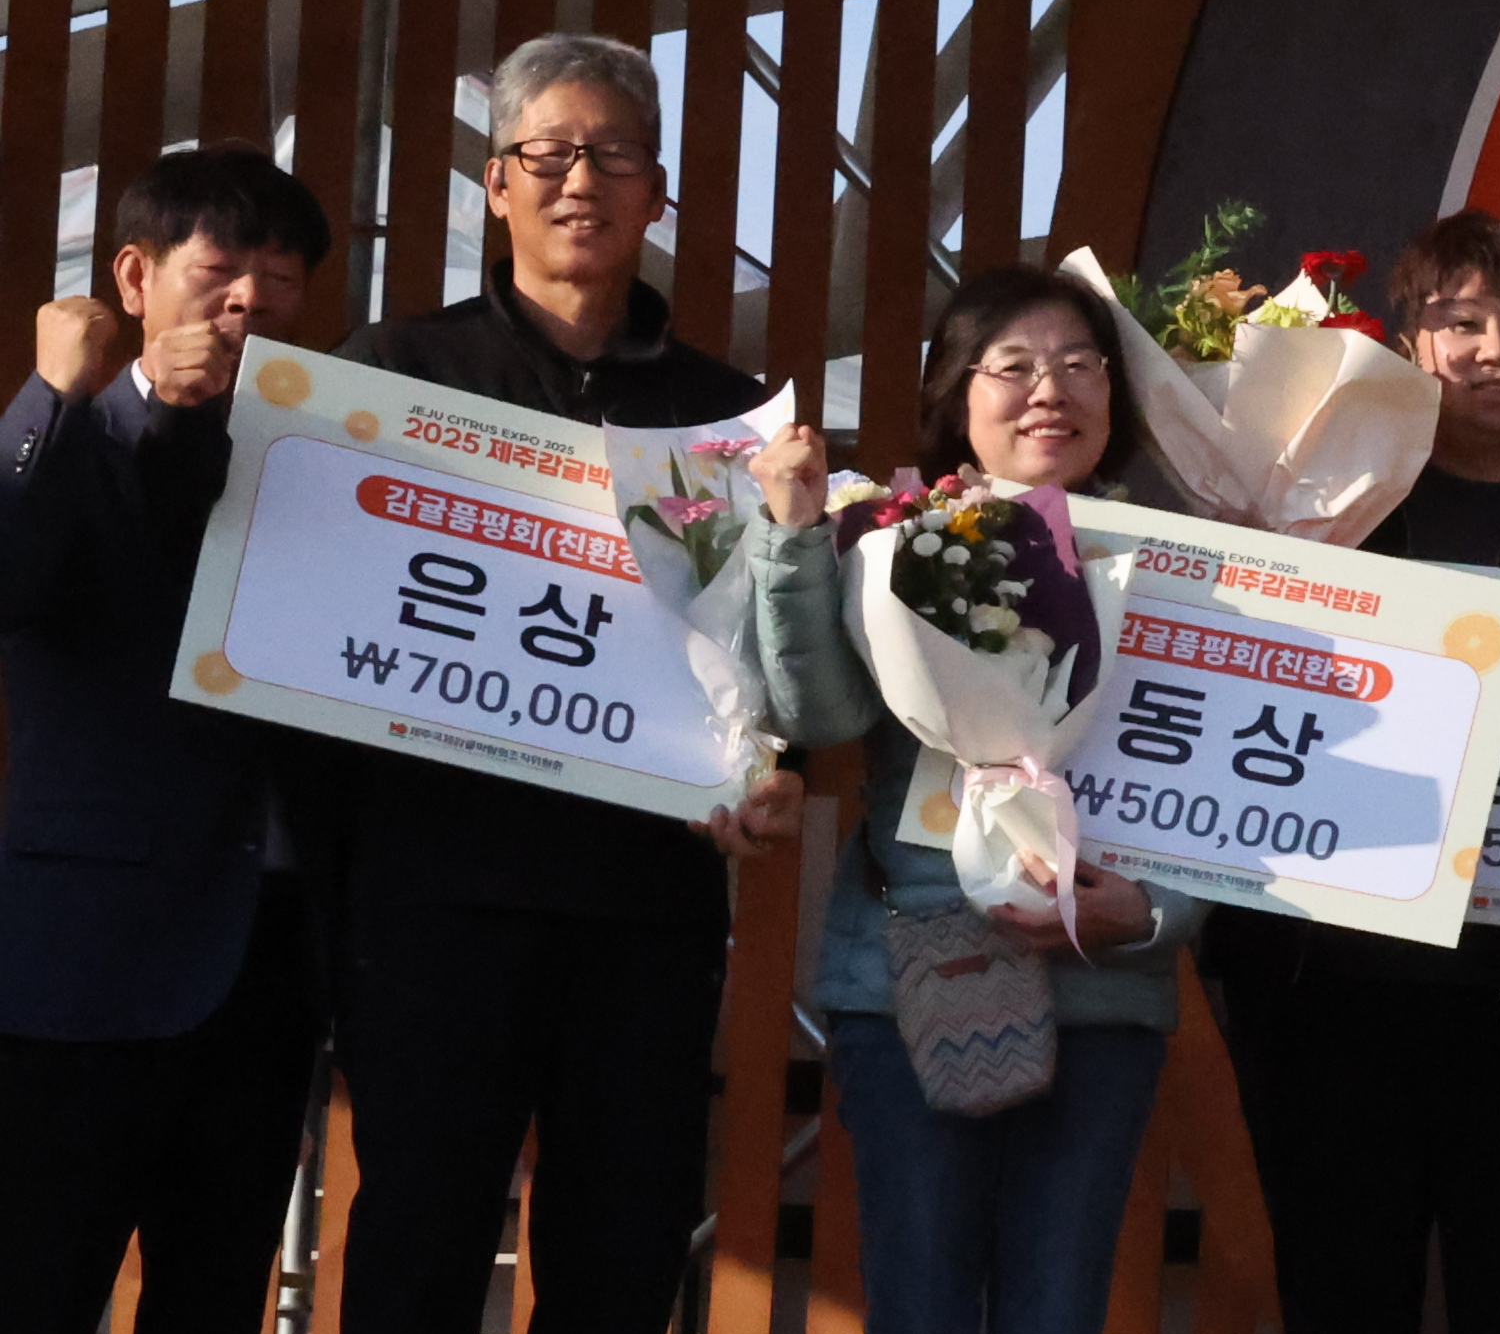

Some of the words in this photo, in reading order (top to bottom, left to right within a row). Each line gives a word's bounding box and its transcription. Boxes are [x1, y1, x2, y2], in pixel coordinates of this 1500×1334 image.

[403, 417, 481, 455] 2025
[486, 437, 612, 490] 제주감귤박
[408, 405, 444, 421] JEJU
[447, 414, 498, 436] CITRUS
[501, 428, 540, 446] EXPO
[544, 439, 575, 455] 2025
[1135, 548, 1208, 581] 2025
[1213, 563, 1381, 617] 제주감귤박람회
[1139, 536, 1174, 550] JEJU
[1177, 543, 1225, 560] CITRUS
[1229, 553, 1266, 568] EXPO
[1270, 561, 1299, 575] 2025
